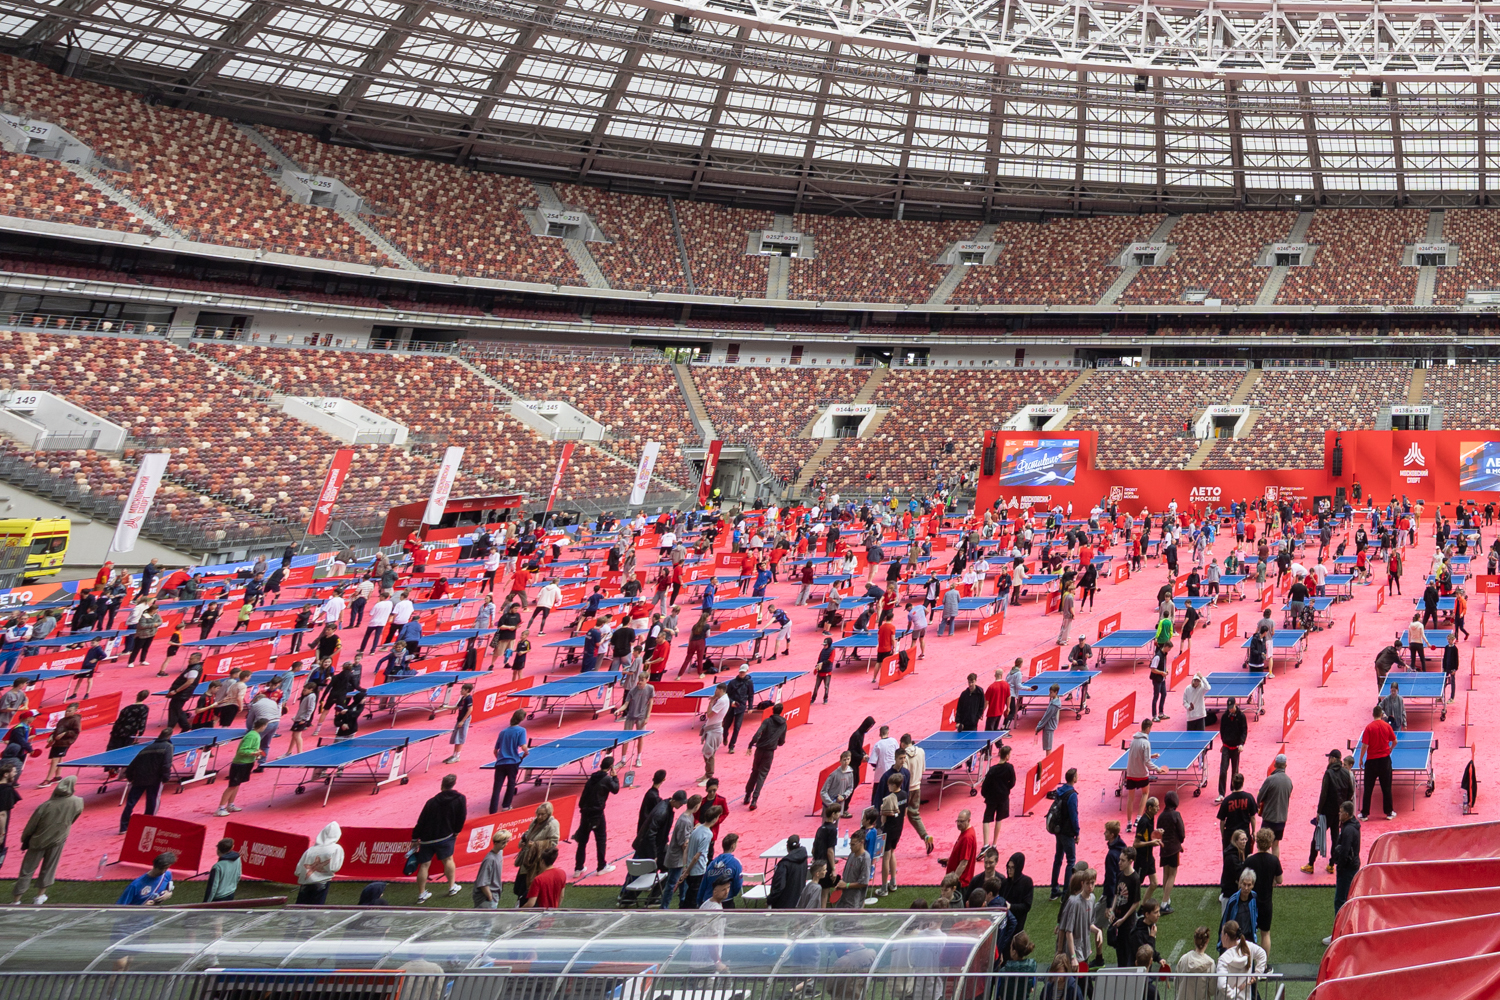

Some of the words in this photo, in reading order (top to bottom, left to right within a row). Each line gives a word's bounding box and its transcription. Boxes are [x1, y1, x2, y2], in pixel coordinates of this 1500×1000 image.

[30, 126, 48, 135] 257
[16, 396, 36, 404] 149
[323, 401, 337, 409] 147
[128, 476, 150, 514] МОСКОВСКИЙ
[1190, 486, 1221, 496] ЛЕТО
[0, 591, 33, 605] ЕТО
[1228, 798, 1248, 812] RUN
[498, 816, 538, 830] Департамен
[251, 841, 287, 859] МОСКОВСКИЙ
[371, 841, 412, 853] МОСКОВСК
[248, 852, 267, 866] СПОРТ
[369, 853, 393, 864] СПОРТ
